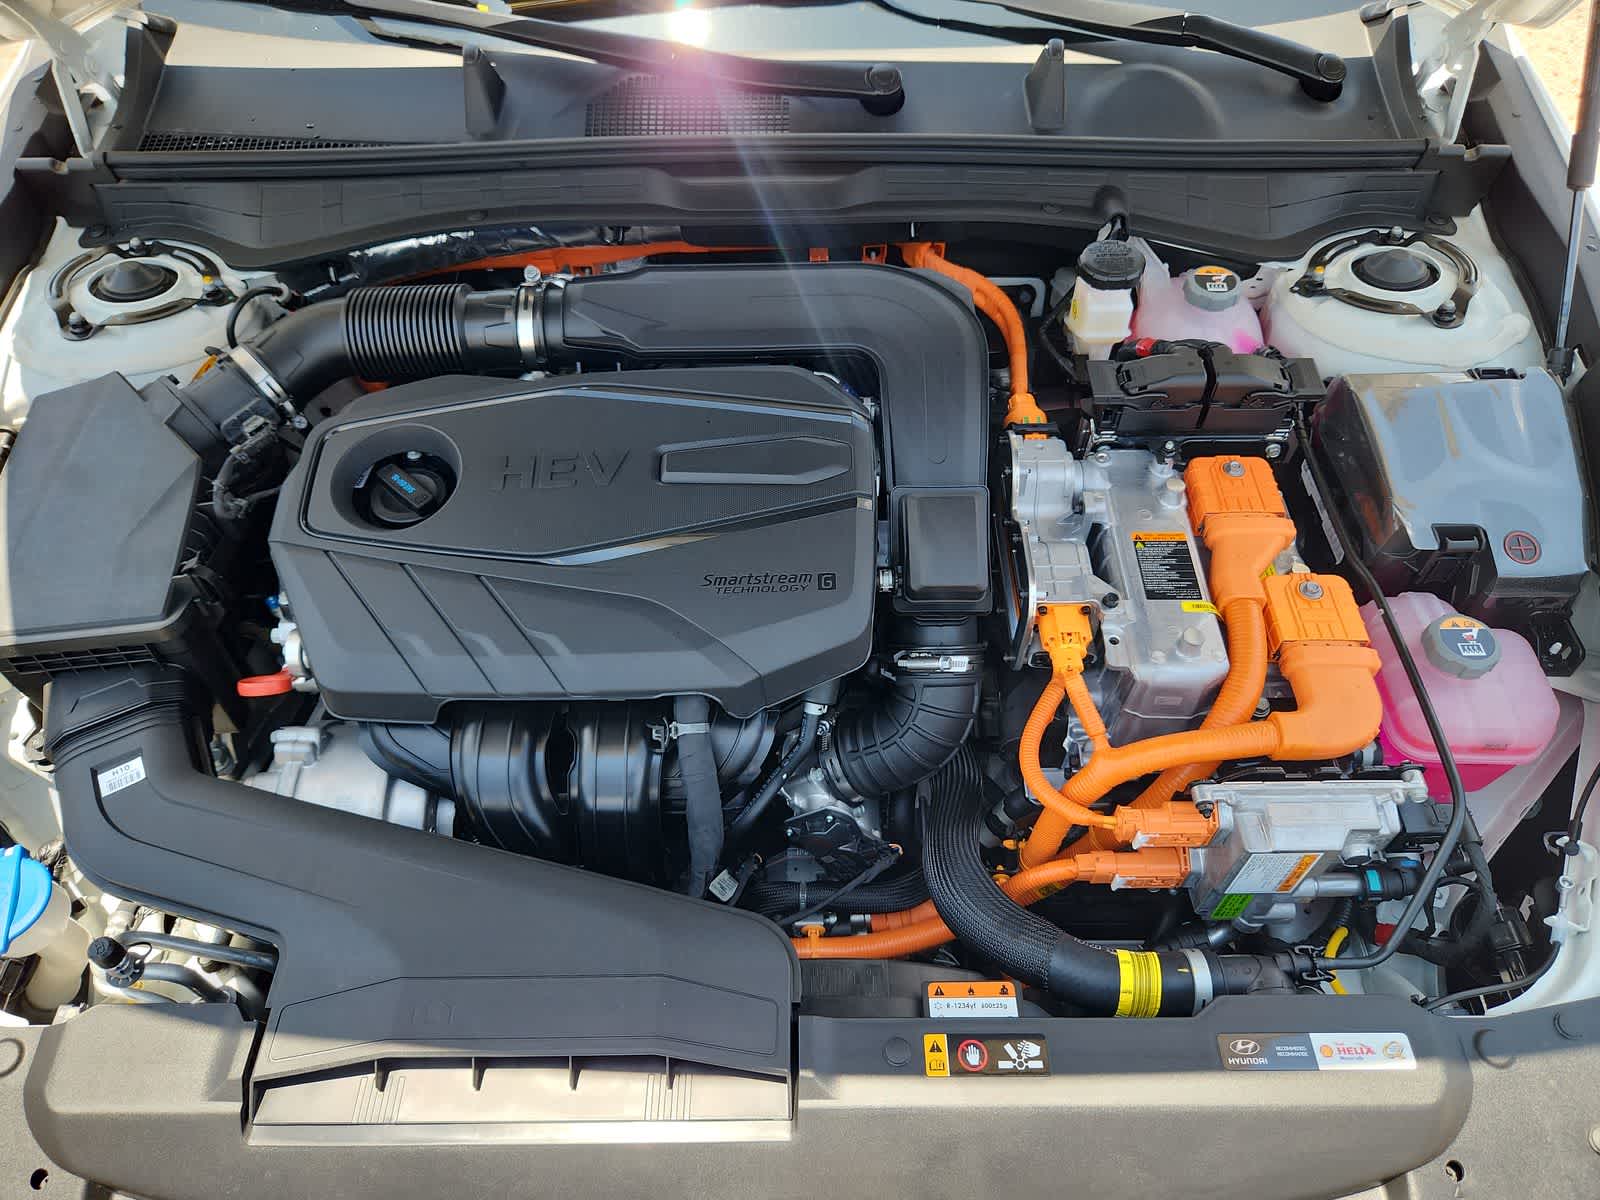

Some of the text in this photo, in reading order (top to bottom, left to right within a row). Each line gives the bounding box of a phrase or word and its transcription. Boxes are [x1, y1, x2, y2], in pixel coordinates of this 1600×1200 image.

[494, 449, 630, 492] HEV
[701, 572, 813, 587] Smartstream
[716, 584, 809, 595] TECHNOLOGY
[1336, 1046, 1376, 1056] HELIX
[1228, 1057, 1269, 1065] HYUNDAI
